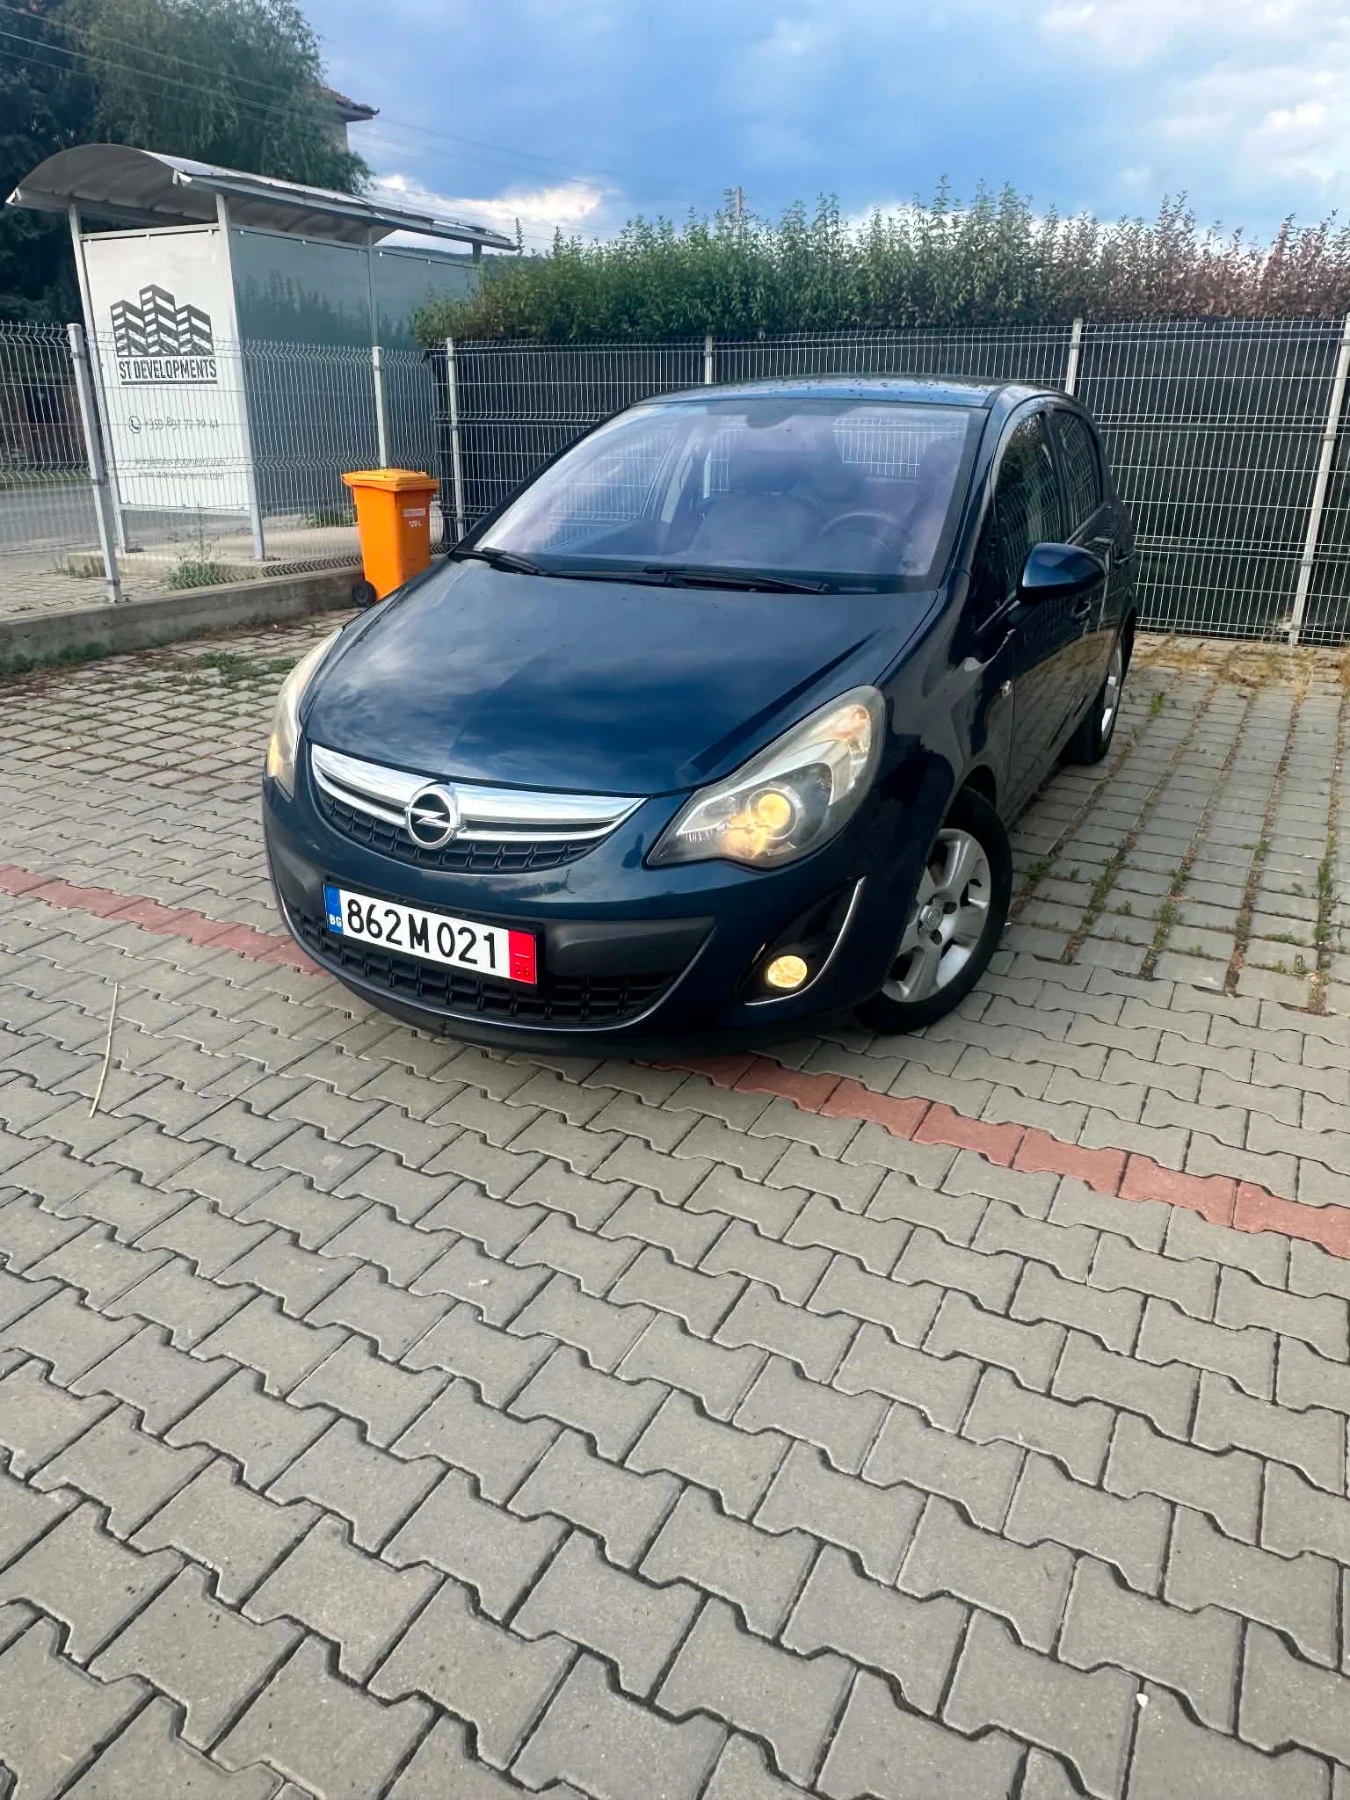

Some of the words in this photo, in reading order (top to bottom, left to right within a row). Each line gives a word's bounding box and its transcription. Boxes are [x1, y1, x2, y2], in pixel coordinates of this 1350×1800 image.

[119, 360, 132, 379] ST
[133, 358, 217, 379] DEVELOPMENTS
[329, 913, 342, 927] BG
